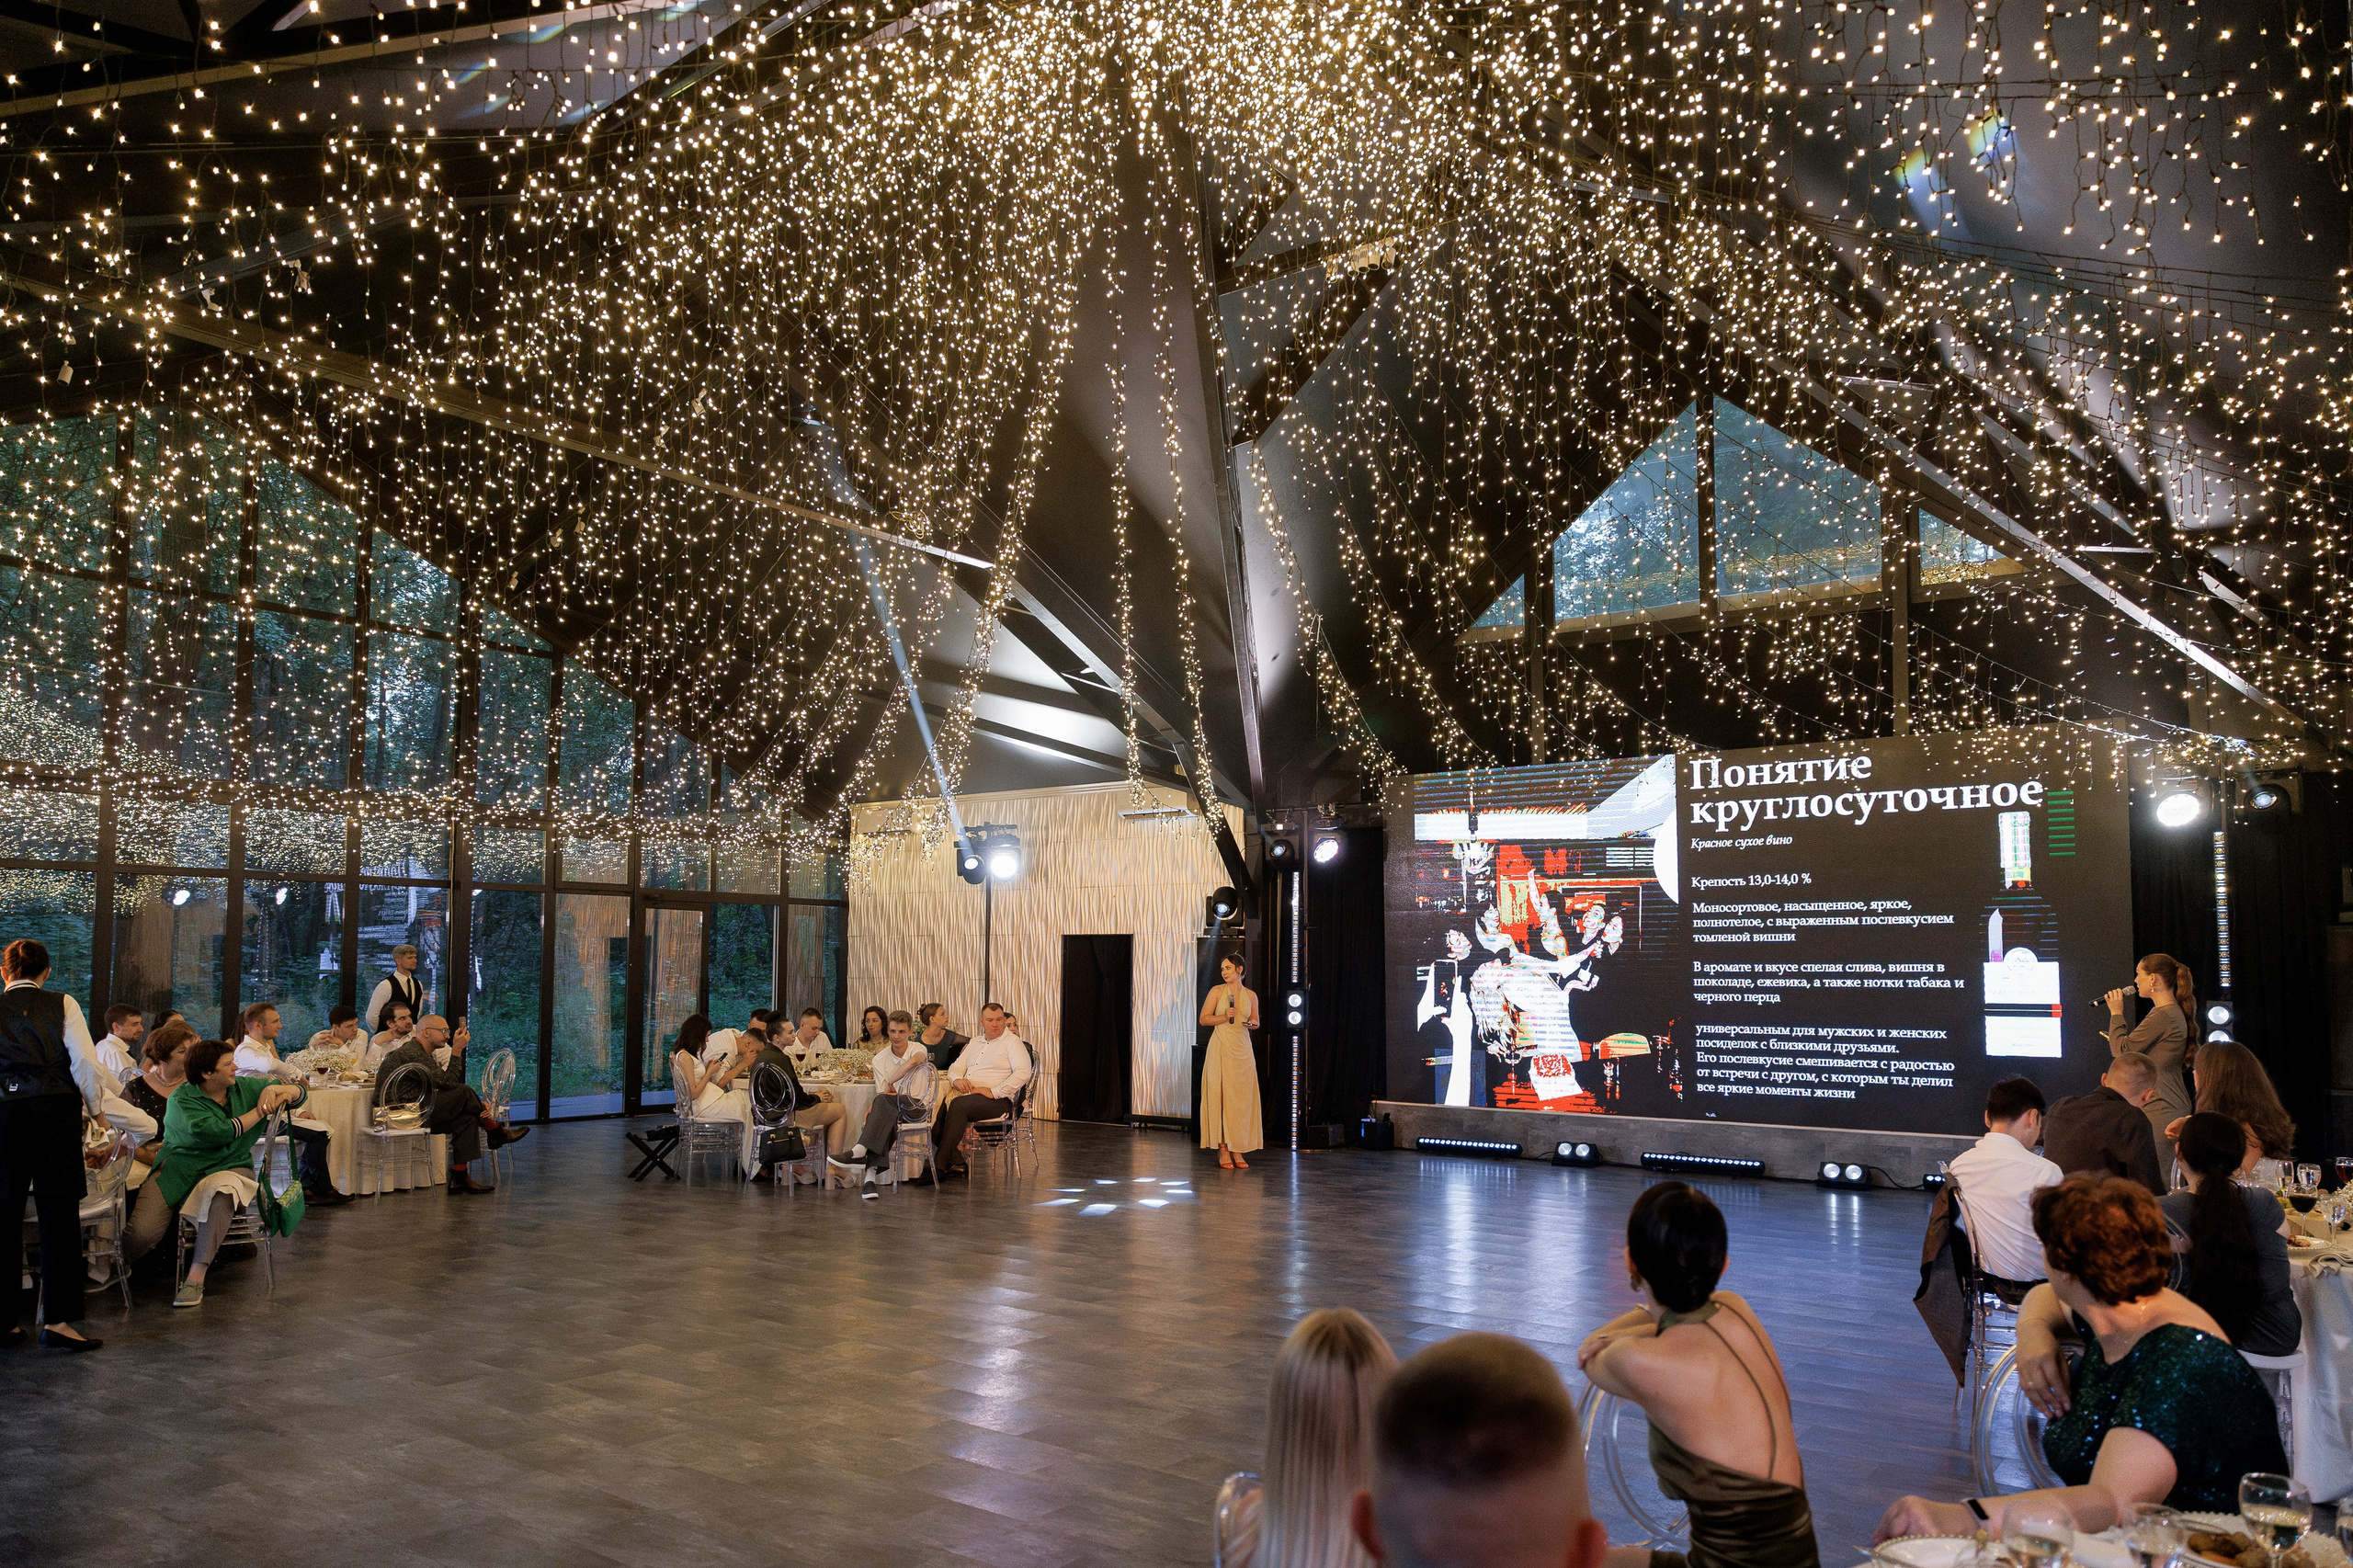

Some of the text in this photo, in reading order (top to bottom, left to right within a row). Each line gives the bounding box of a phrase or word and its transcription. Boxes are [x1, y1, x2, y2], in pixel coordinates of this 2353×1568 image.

[1689, 754, 1872, 790] Понятие
[1689, 779, 2044, 833] круглосуточное
[1689, 834, 1793, 852] Красное сухое вино
[1690, 872, 1813, 891] Крепость 13,0-14,0 %
[1691, 900, 1913, 916] Моносортовое, насыщенное, яркое,
[1692, 915, 1955, 930] полнотелое, с выраженным послевкусием
[1692, 931, 1797, 943] томленой вишни
[1692, 960, 1946, 976] В аромате и вкусе спелая слива, вишня в
[1692, 976, 1965, 990] шоколаде, ежевика, а также нотки табака и
[1693, 993, 1781, 1006] черного перца
[1695, 1025, 1948, 1040] универсальным для мужских и женских
[1695, 1038, 1900, 1056] посиделок с близкими друзьями.
[1696, 1051, 1956, 1073] Его послевкусие смешивается с радостью
[1696, 1068, 1954, 1088] от встречи с другом, с которым ты делил
[1696, 1083, 1856, 1099] все яркие моменты жизни
